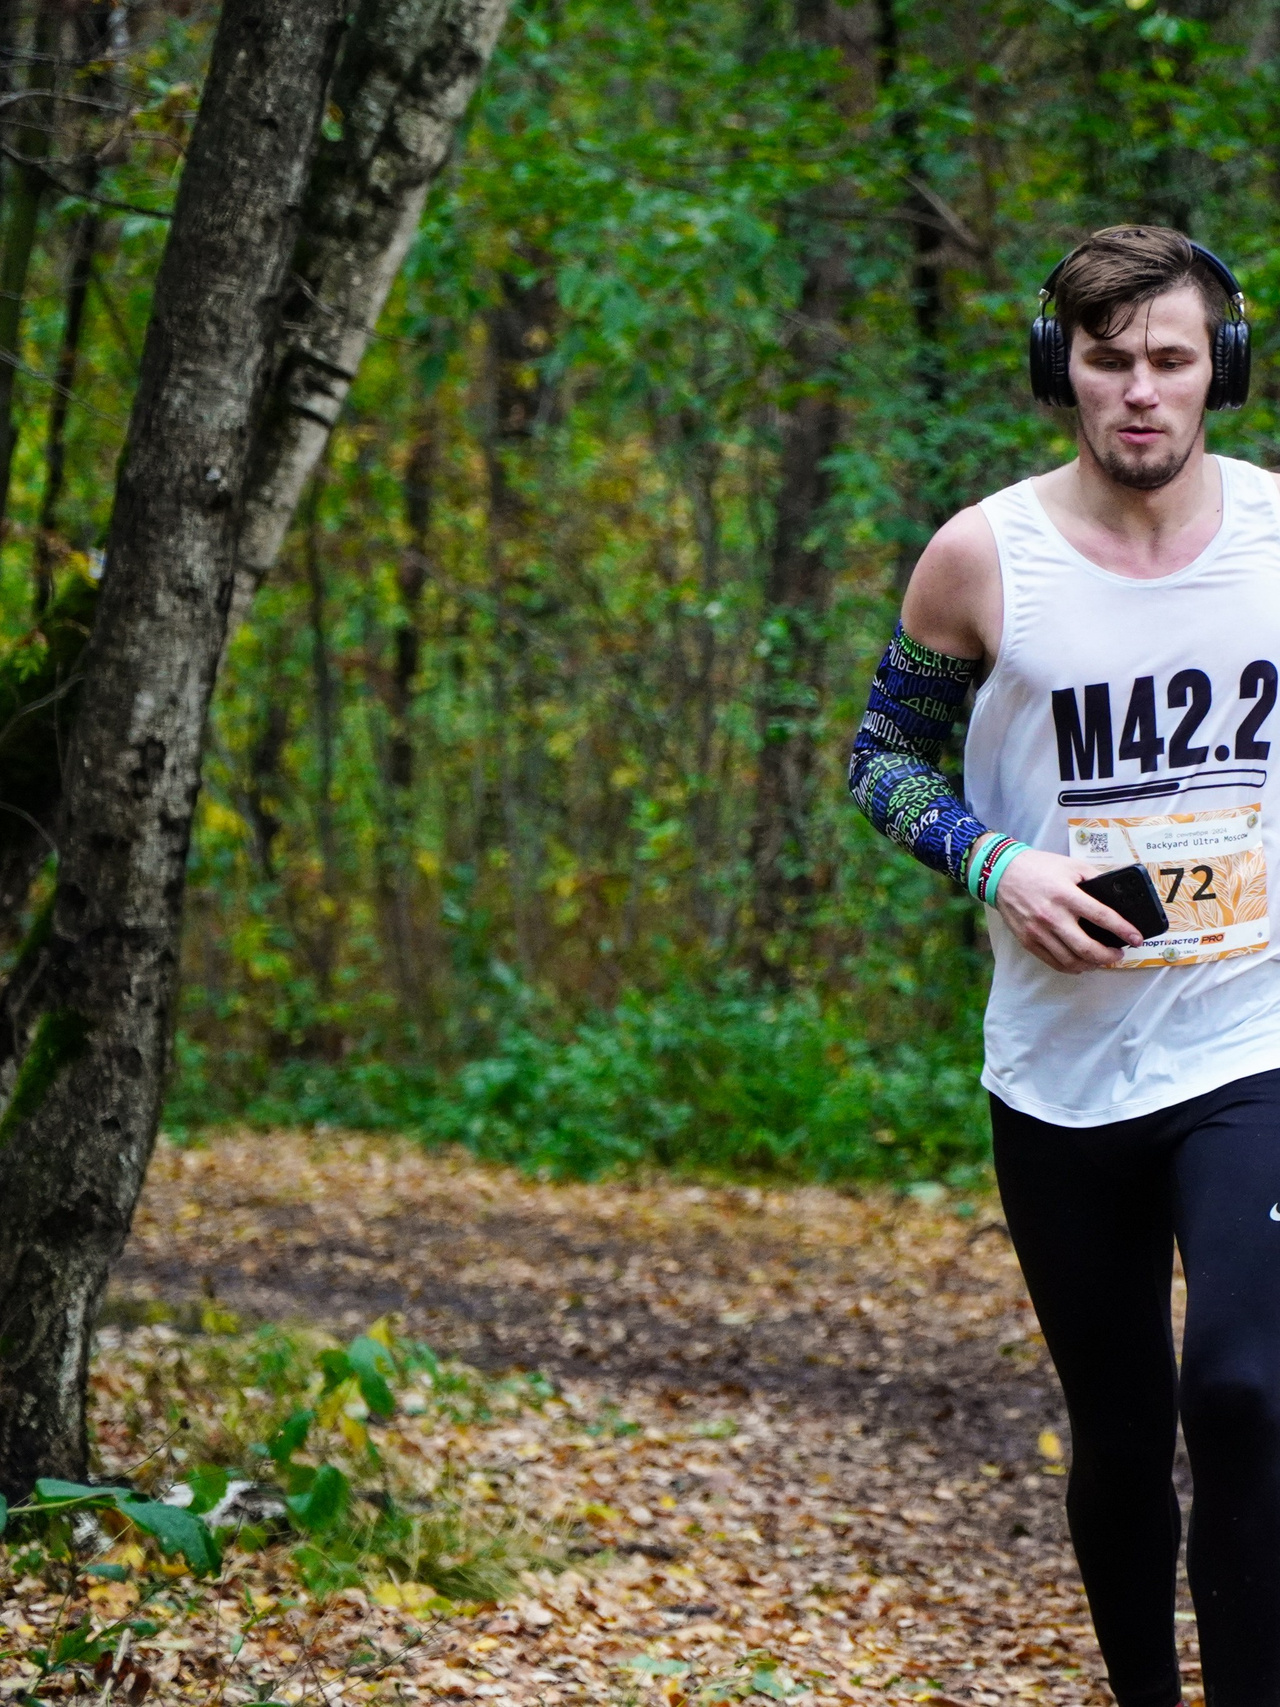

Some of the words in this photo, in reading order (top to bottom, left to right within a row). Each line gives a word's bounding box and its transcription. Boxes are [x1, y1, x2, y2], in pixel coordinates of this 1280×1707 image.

[1052, 660, 1278, 781] M42.2
[1146, 839, 1188, 850] Backyard
[1193, 837, 1219, 846] Ultra
[1223, 832, 1248, 842] Moscow
[1201, 934, 1224, 944] PRO
